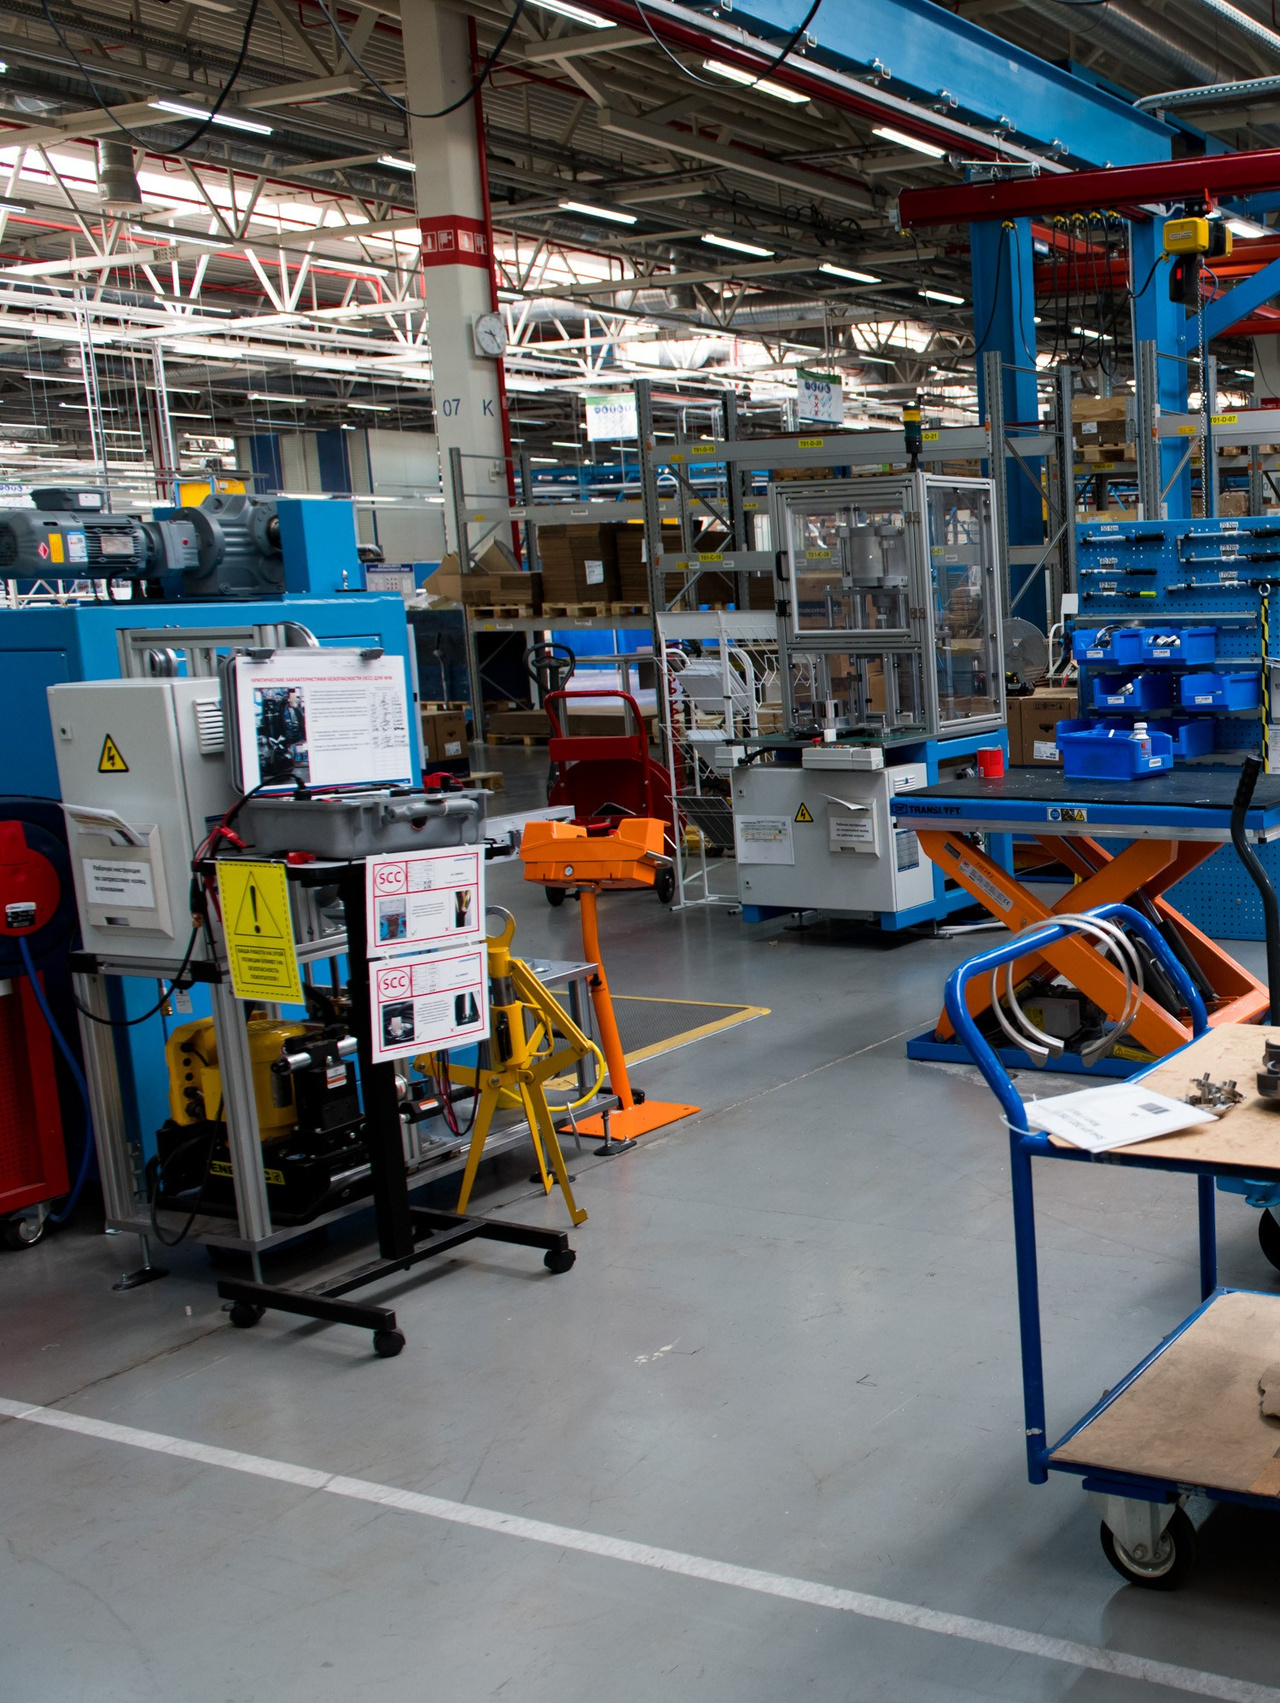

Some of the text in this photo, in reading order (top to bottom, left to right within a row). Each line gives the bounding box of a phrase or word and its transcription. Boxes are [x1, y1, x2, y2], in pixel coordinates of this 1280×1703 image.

[443, 399, 494, 416] 07 K
[800, 439, 823, 447] T01-D-20
[379, 871, 402, 884] SCC
[383, 976, 406, 990] SCC
